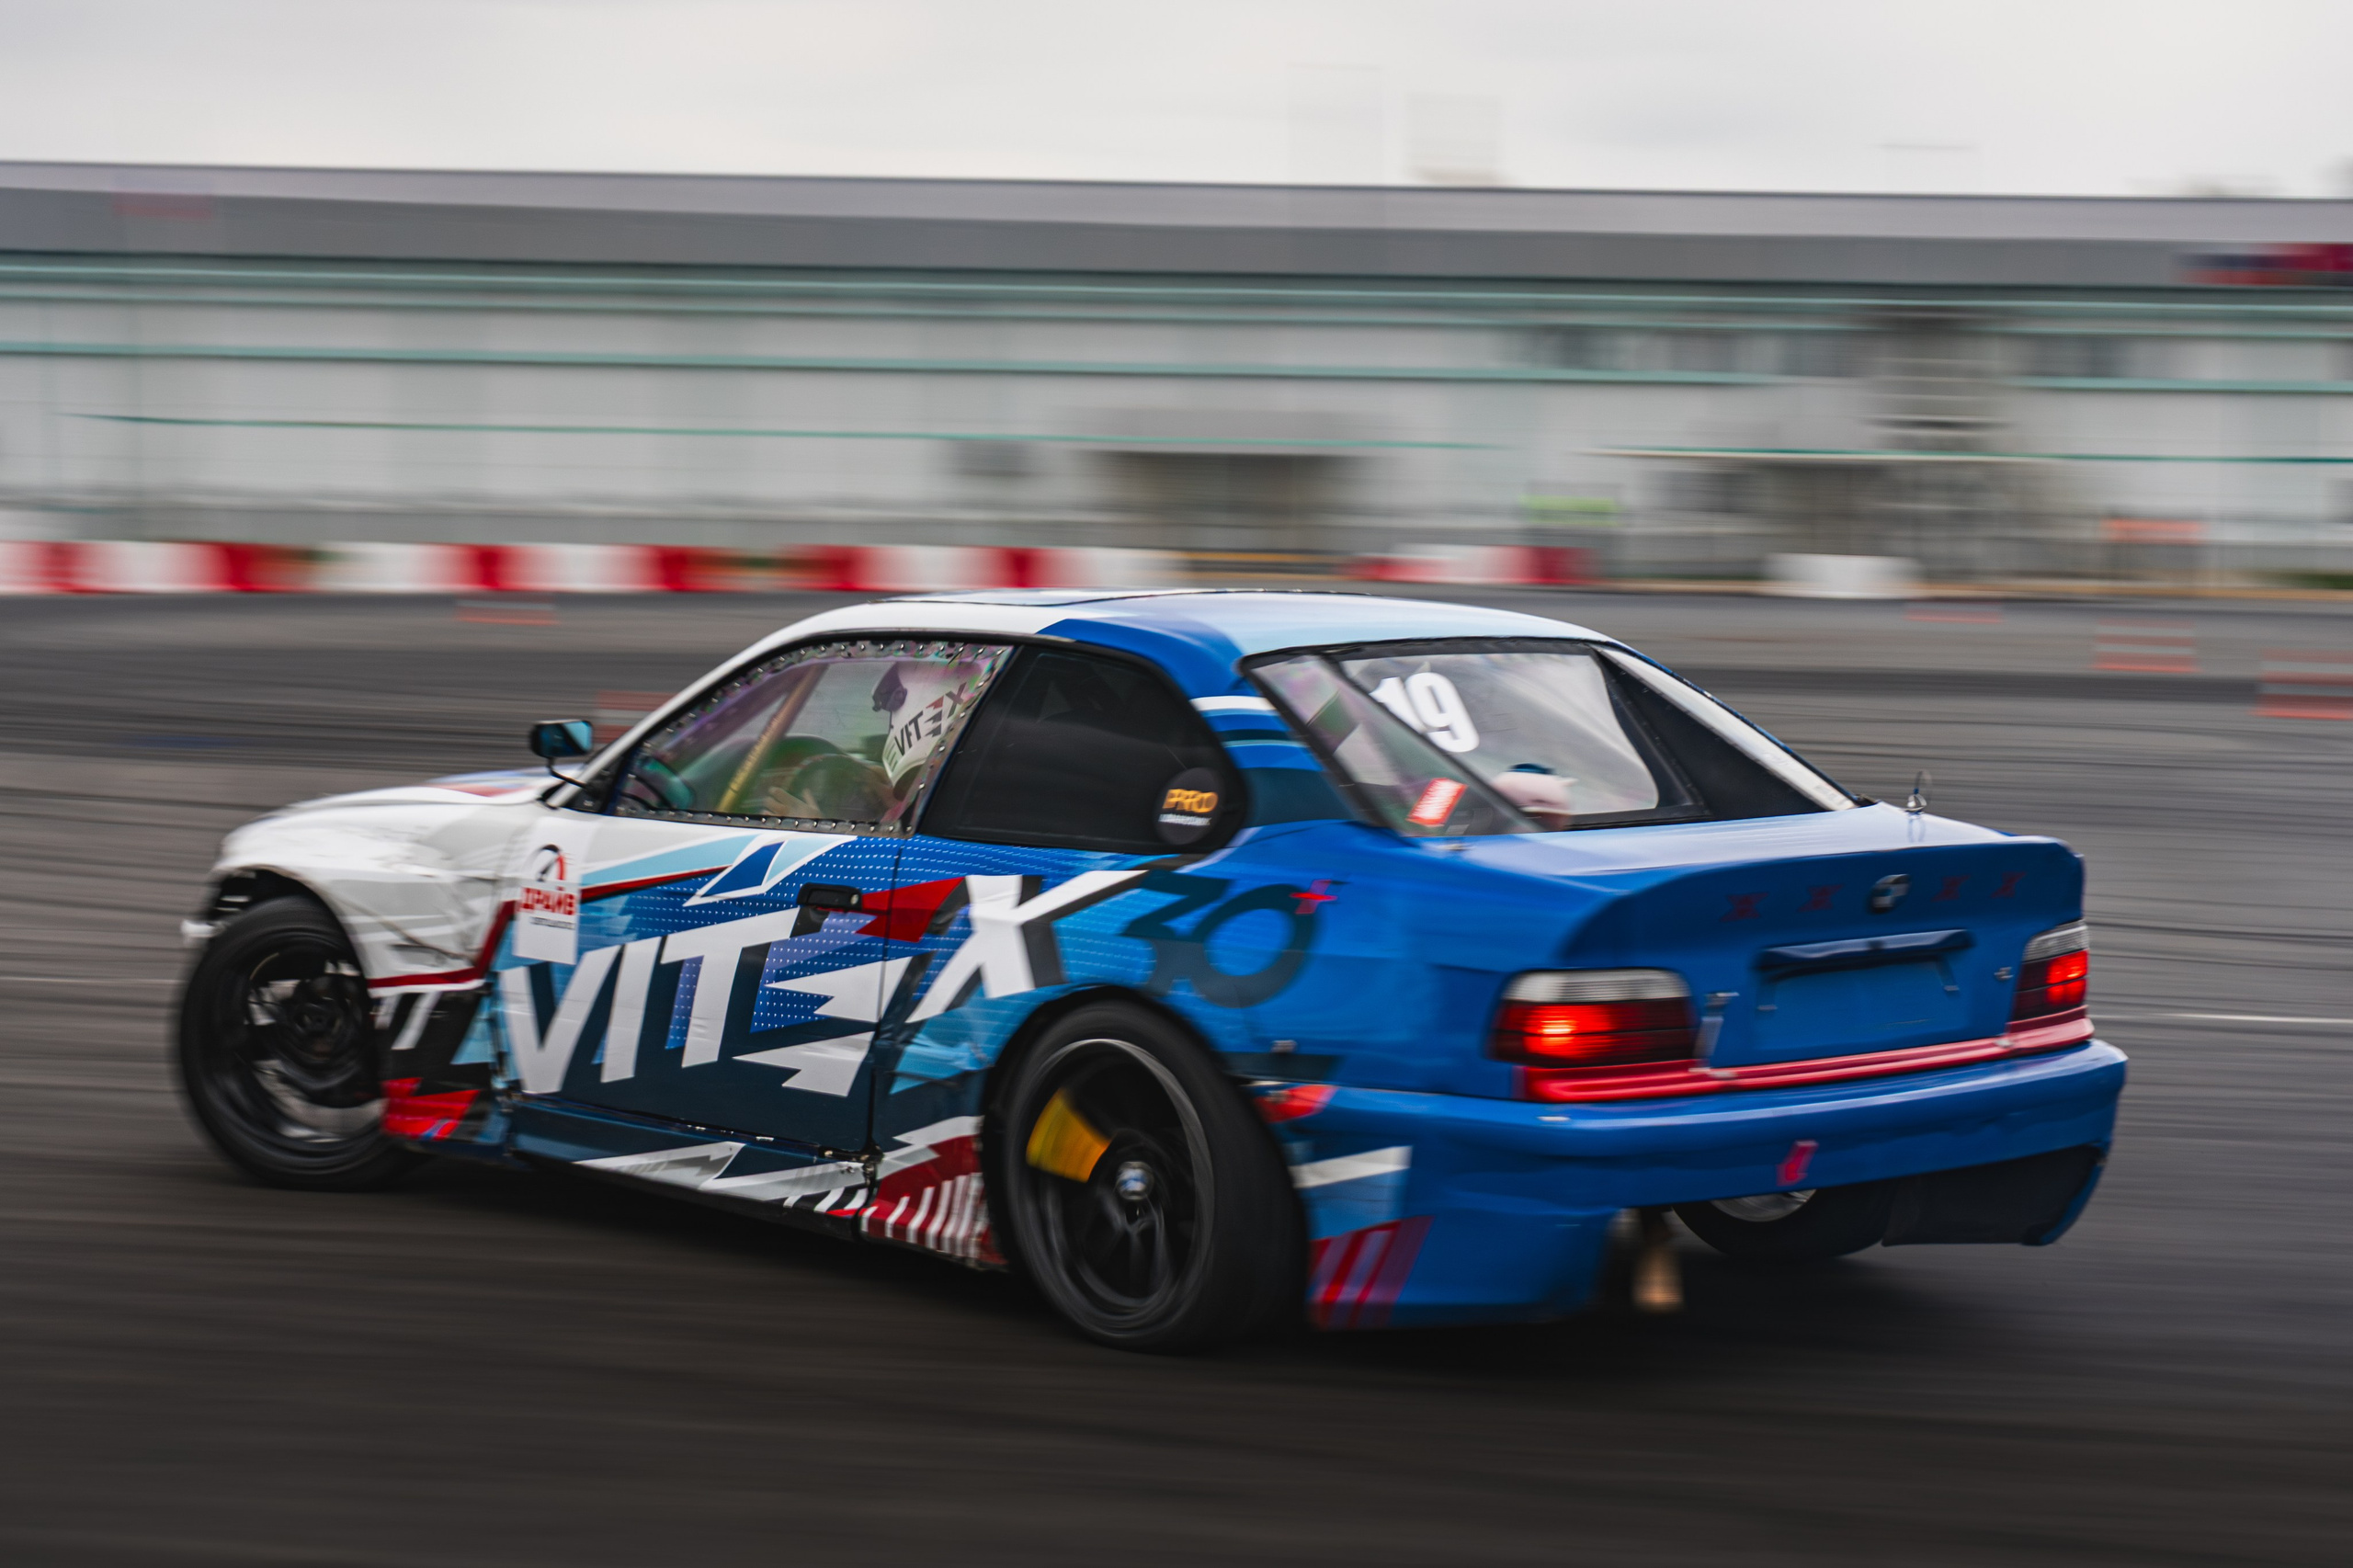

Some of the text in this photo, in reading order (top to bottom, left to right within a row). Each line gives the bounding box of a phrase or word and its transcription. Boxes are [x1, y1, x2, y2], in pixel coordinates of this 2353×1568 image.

[1370, 672, 1481, 753] 19
[1162, 789, 1219, 813] PRO
[499, 869, 1152, 1097] VITEX
